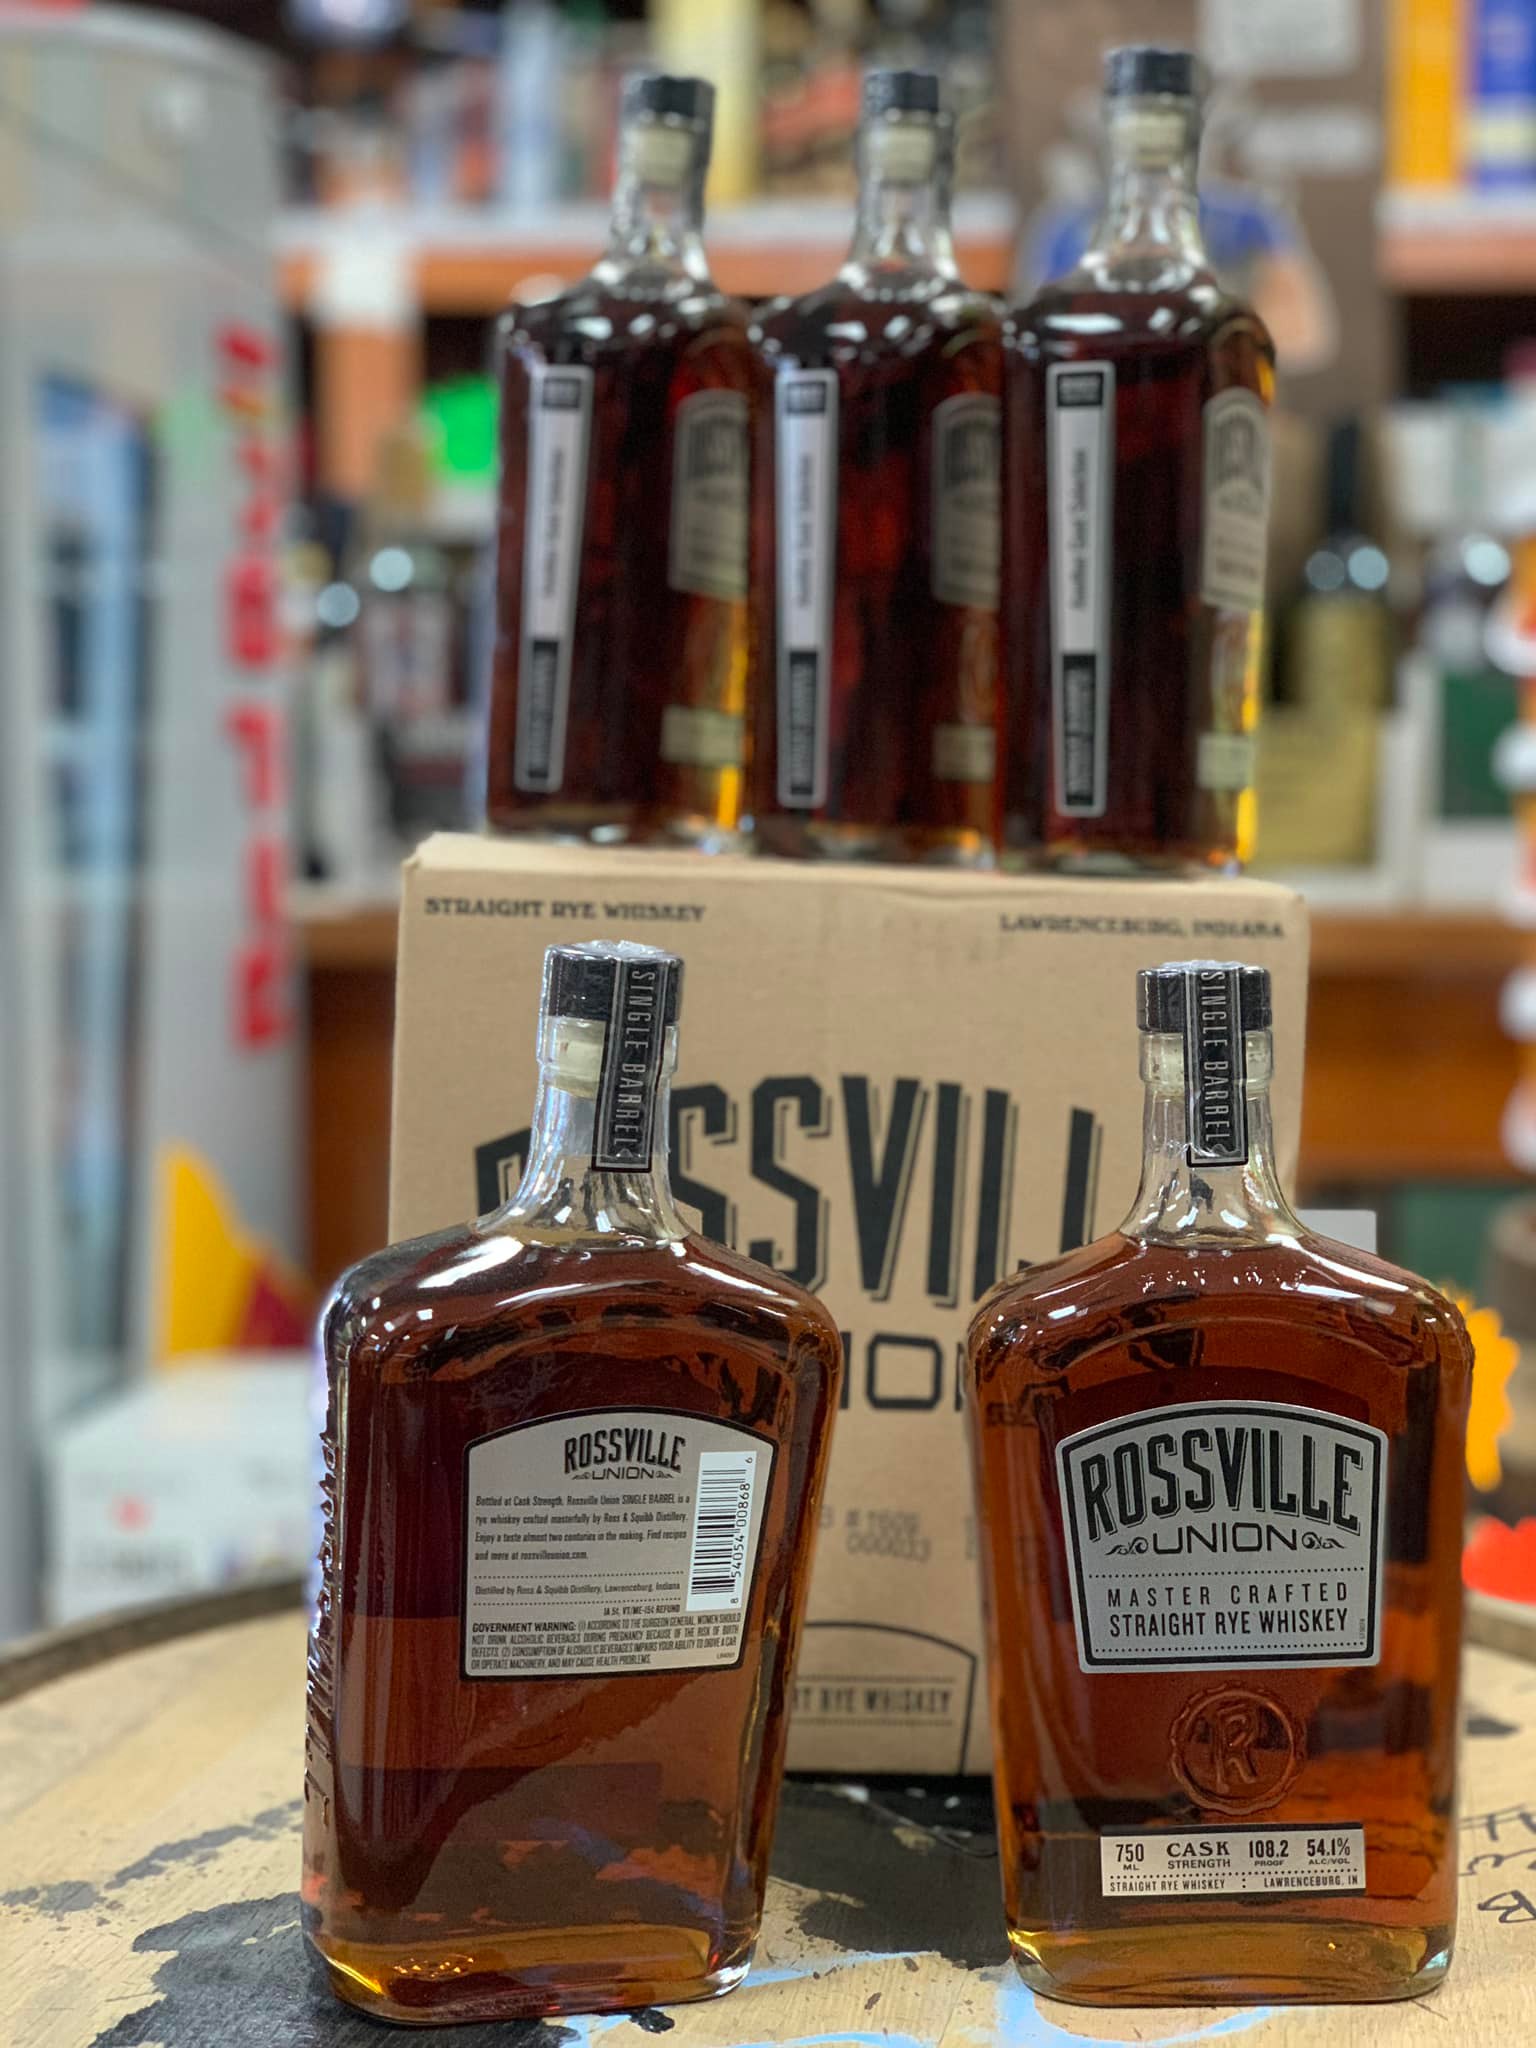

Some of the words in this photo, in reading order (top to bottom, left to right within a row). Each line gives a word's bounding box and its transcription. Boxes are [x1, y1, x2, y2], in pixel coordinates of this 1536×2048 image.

[425, 897, 543, 918] STRAIGHT
[551, 901, 597, 919] RYE
[603, 904, 705, 921] WHISKEY
[1192, 919, 1285, 938] INDIANA
[625, 970, 655, 1049] SINGLE
[1200, 971, 1228, 1047] SINGLE
[614, 1063, 646, 1145] BARREL
[1204, 1060, 1231, 1142] BARREL
[564, 1428, 687, 1474] ROSSVILLE
[592, 1466, 654, 1480] UNION
[1080, 1427, 1363, 1542] ROSSVILLE
[476, 1496, 502, 1506] Bottled
[514, 1496, 530, 1506] Cask
[567, 1495, 598, 1506] Rossville
[600, 1495, 620, 1505] Union
[622, 1494, 646, 1504] SINGLE
[649, 1493, 675, 1504] BARREL
[737, 1483, 751, 1528] 00868
[476, 1516, 488, 1526] rye
[490, 1513, 520, 1526] whiskey
[523, 1514, 548, 1524] crafted
[551, 1513, 590, 1525] masterfully
[592, 1513, 600, 1524] by
[604, 1513, 620, 1522] Ross
[623, 1512, 628, 1522] &
[630, 1512, 653, 1524] Squibb
[475, 1532, 495, 1544] Enjoy
[504, 1533, 521, 1542] taste
[523, 1532, 547, 1542] almost
[549, 1533, 563, 1542] two
[564, 1532, 596, 1542] centuries
[606, 1531, 616, 1541] the
[647, 1530, 662, 1539] Find
[663, 1531, 687, 1541] recipes
[1153, 1523, 1297, 1554] UNION
[475, 1550, 488, 1560] and
[731, 1535, 745, 1578] 54054
[475, 1585, 505, 1595] Distilled
[506, 1586, 515, 1596] by
[517, 1585, 534, 1595] Ross
[544, 1585, 569, 1596] Squibb
[655, 1581, 680, 1590] Indiana
[1108, 1586, 1210, 1607] MASTER
[1231, 1582, 1347, 1605] CRAFTED
[656, 1604, 681, 1614] REFUND
[472, 1622, 533, 1633] GOVERNMENT
[534, 1621, 577, 1632] WARNING:
[1110, 1613, 1206, 1637] STRAIGHT
[1216, 1611, 1251, 1634] RYE
[1260, 1608, 1348, 1633] WHISKEY
[1116, 1843, 1145, 1862] 750
[1166, 1841, 1230, 1858] CASK
[1248, 1839, 1289, 1858] 108.2
[1307, 1837, 1351, 1857] 54.1%
[1167, 1859, 1231, 1870] STRENGTH
[1308, 1858, 1350, 1866] ALC/VOL
[1110, 1881, 1157, 1892] STRAIGHT
[1161, 1880, 1179, 1891] RYE
[1183, 1879, 1226, 1890] WHISKEY
[1348, 1875, 1358, 1886] IN
